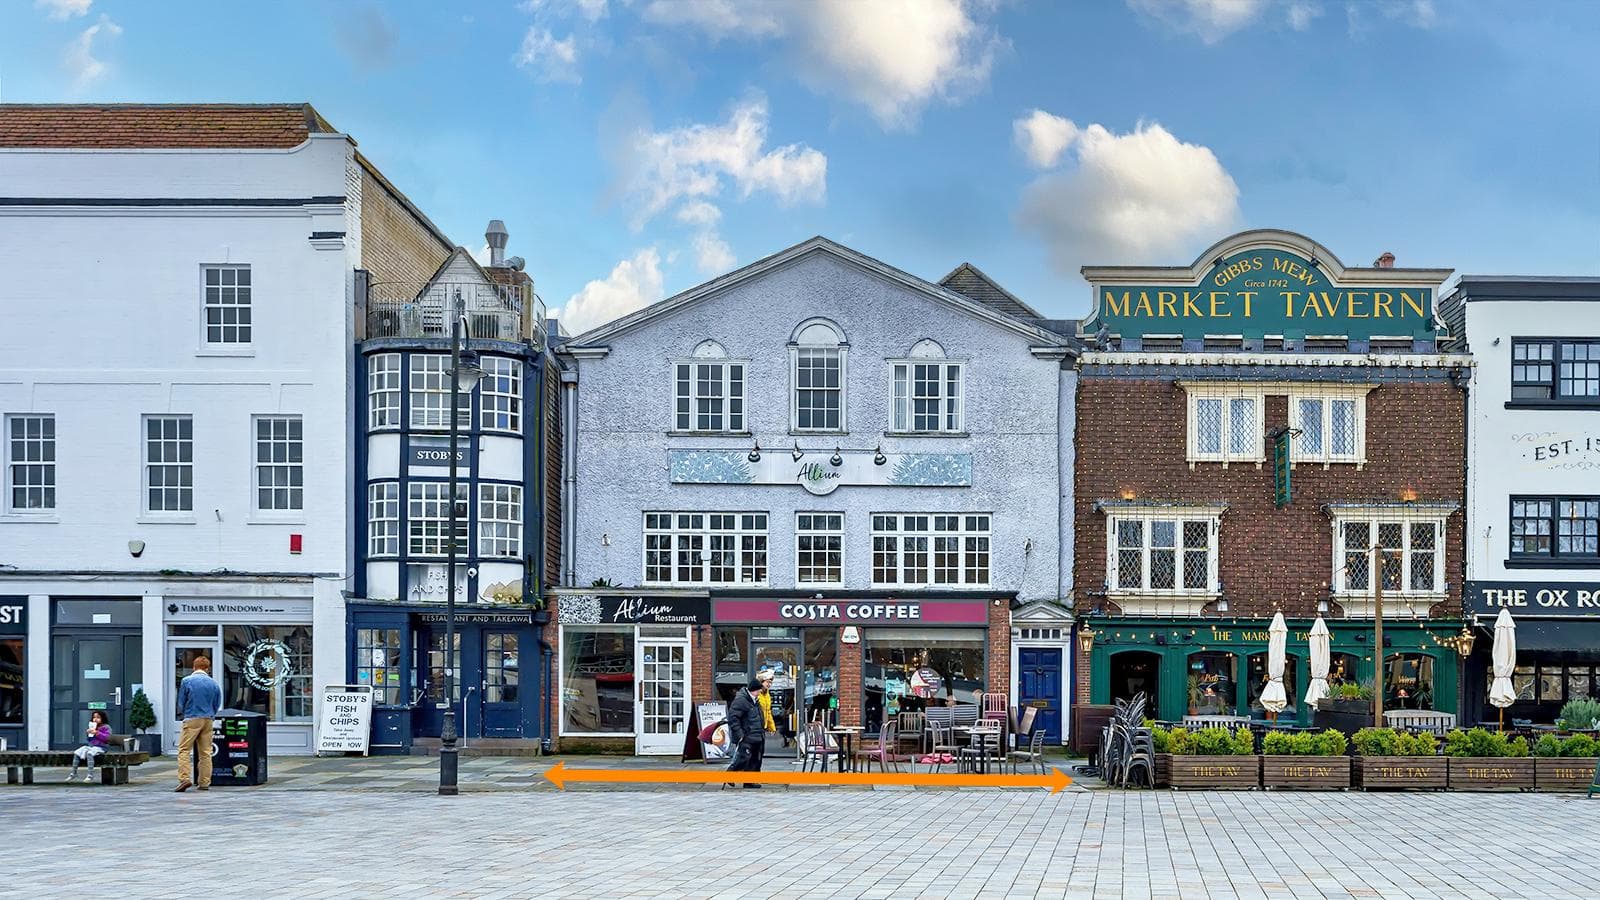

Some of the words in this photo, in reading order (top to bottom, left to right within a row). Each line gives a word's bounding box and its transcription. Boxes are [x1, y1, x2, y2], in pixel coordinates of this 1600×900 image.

[1214, 256, 1263, 287] GIBBS
[1272, 257, 1318, 286] MEW
[1244, 279, 1265, 288] Circa
[1268, 279, 1288, 288] 1742
[1104, 291, 1259, 318] MARKET
[1279, 291, 1425, 319] TAVERN
[1535, 439, 1579, 461] EST.
[416, 450, 463, 461] STOBS
[796, 462, 841, 482] Allium
[1482, 589, 1528, 607] THE
[1536, 589, 1570, 607] OX
[181, 604, 215, 613] TIMBER
[217, 604, 263, 613] WINDOWS
[781, 604, 840, 620] COSTA
[846, 604, 920, 619] COFFEE
[421, 615, 469, 623] RESTAUANT
[654, 613, 697, 622] Restaurant
[1212, 631, 1232, 641] THE
[1241, 632, 1271, 641] MARK
[326, 694, 367, 703] STOBY'S
[335, 705, 357, 713] FISH
[329, 717, 359, 726] CHIPS
[322, 741, 342, 749] OPEN
